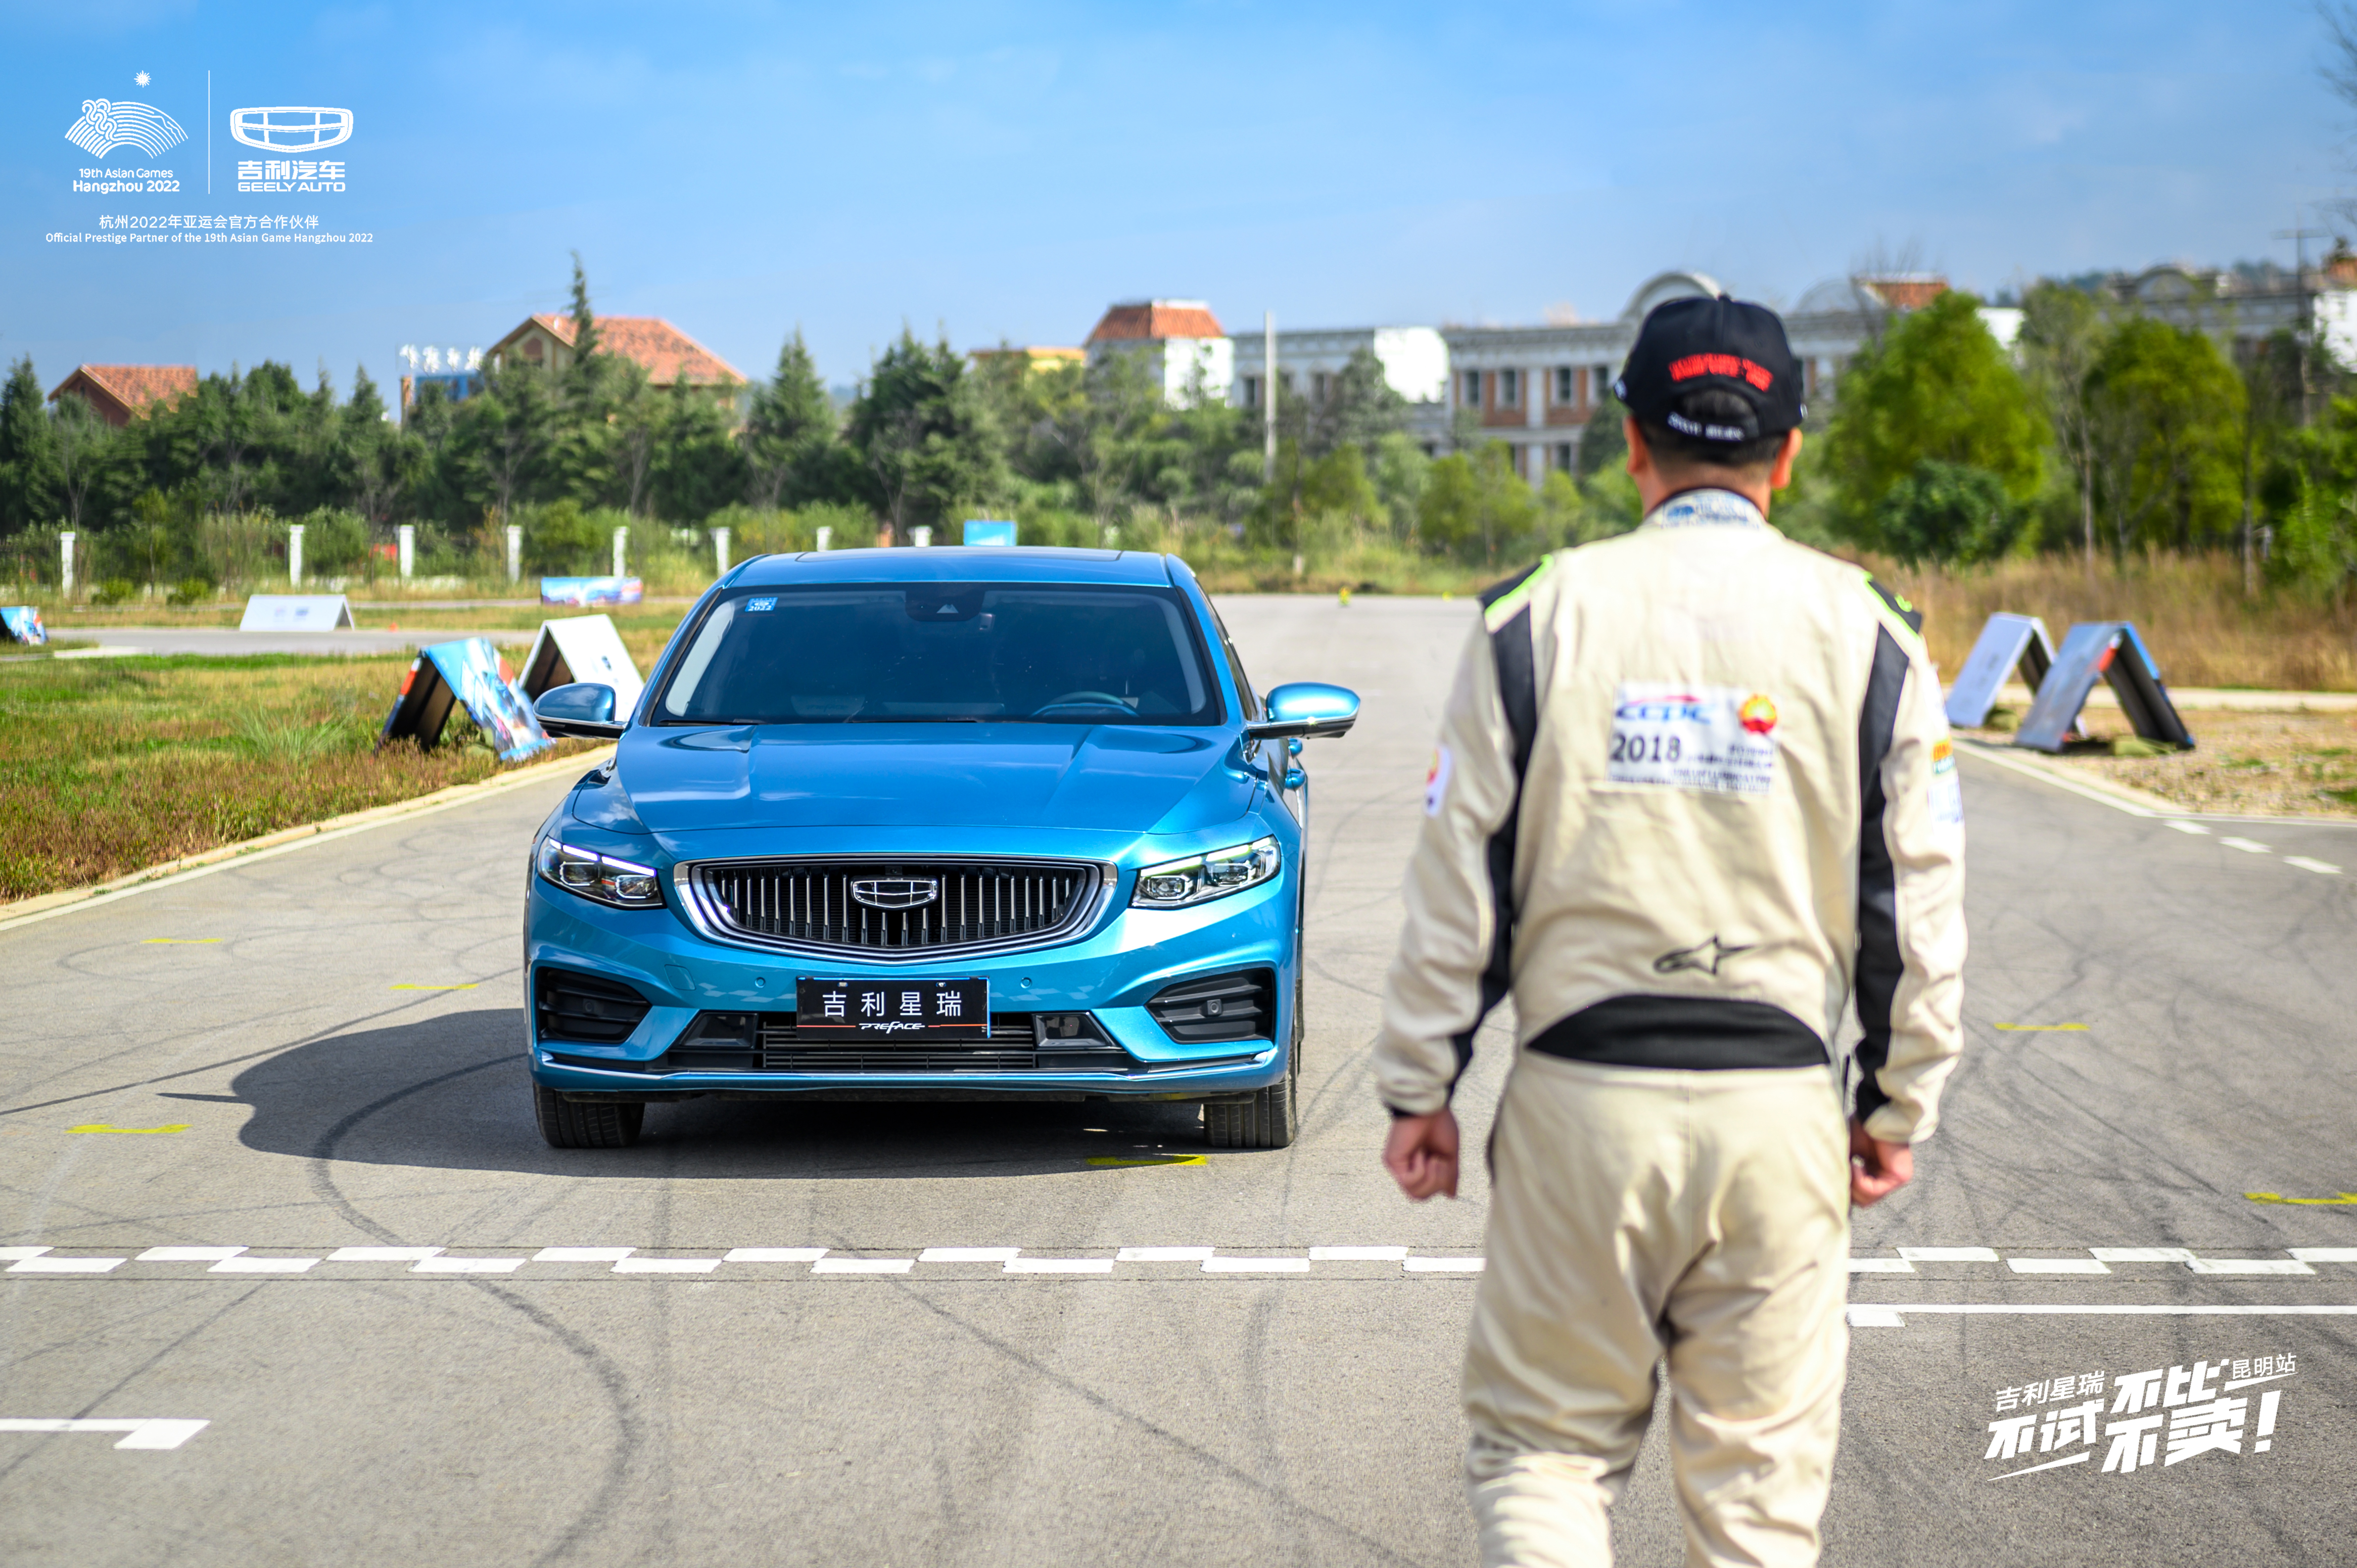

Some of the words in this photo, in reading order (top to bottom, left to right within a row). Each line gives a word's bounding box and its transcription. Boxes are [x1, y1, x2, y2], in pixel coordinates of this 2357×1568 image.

[1610, 732, 1681, 763] 2018
[822, 990, 962, 1017] 吉利星瑞
